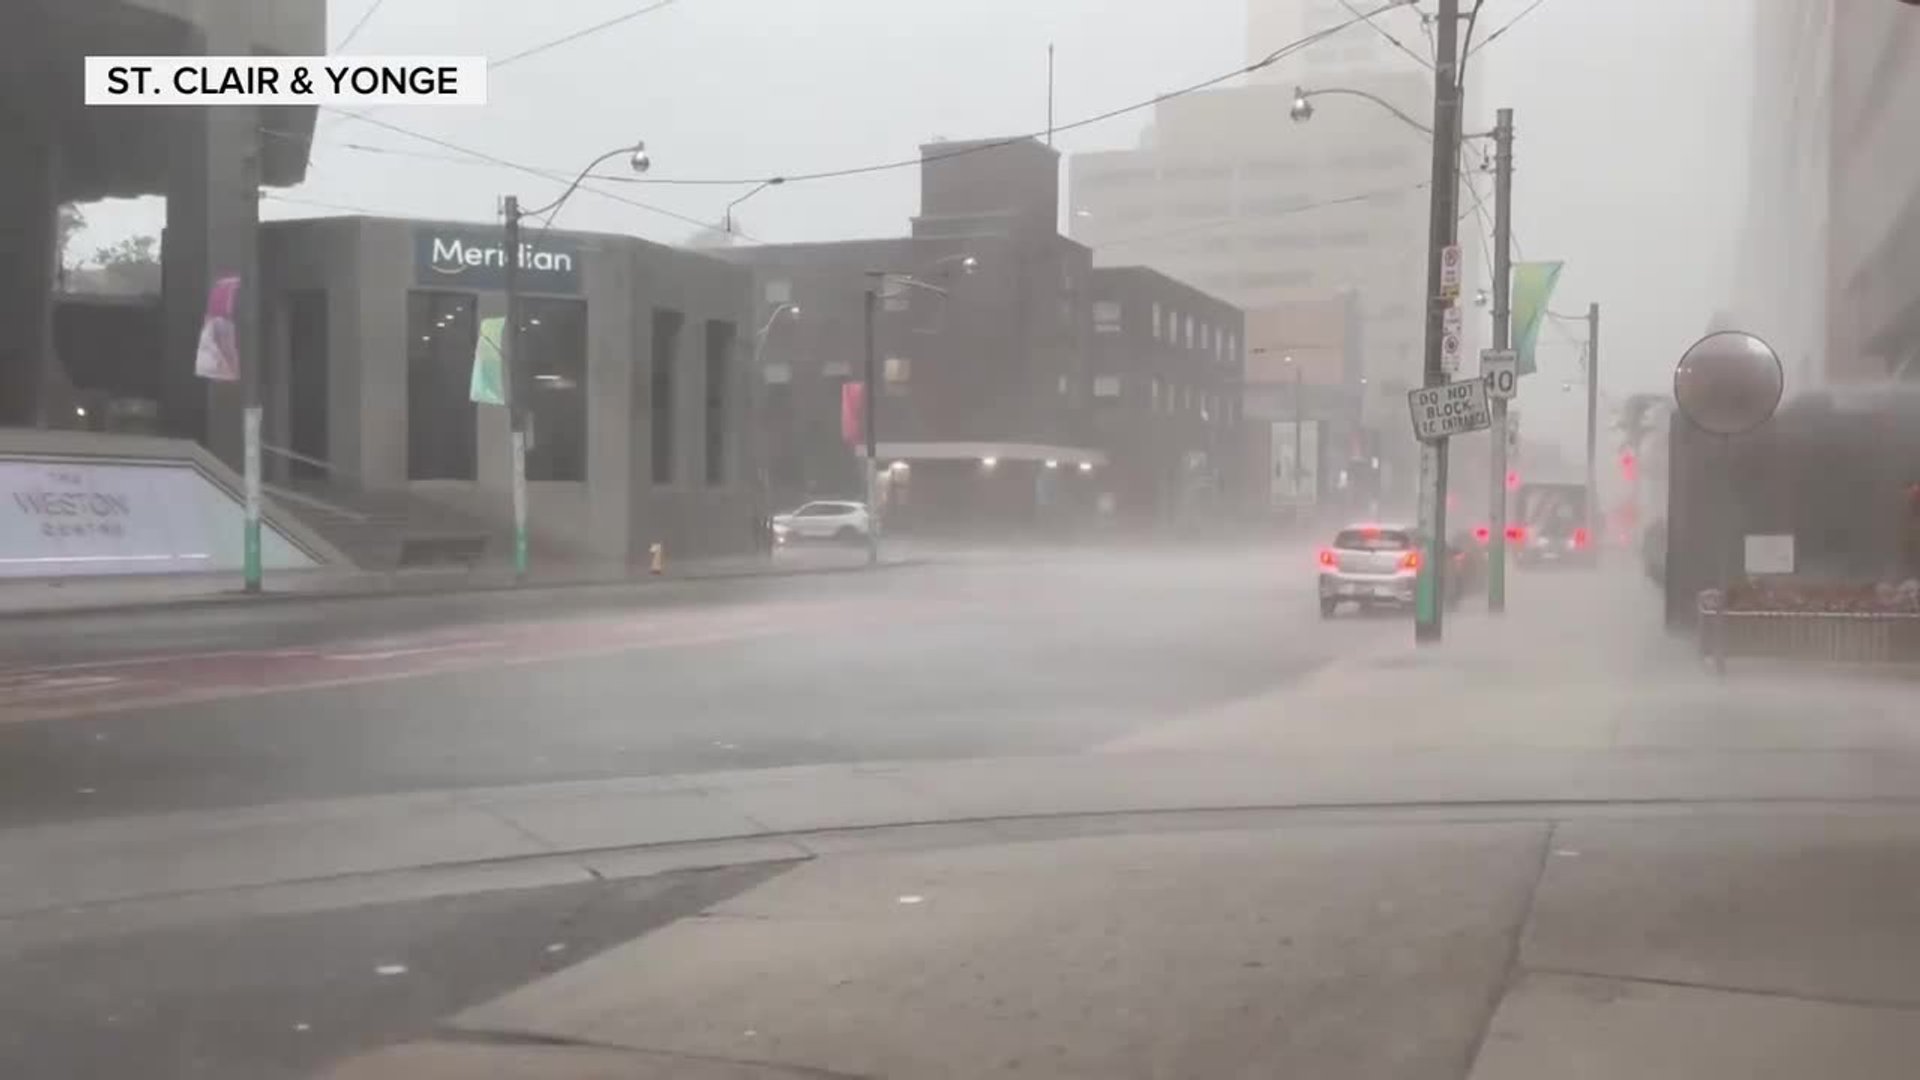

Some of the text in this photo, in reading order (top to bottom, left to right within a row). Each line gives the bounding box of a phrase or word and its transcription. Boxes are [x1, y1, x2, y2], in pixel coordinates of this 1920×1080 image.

[1484, 370, 1513, 392] 40
[1419, 384, 1473, 405] DO NOT
[1426, 399, 1471, 418] BLOCK
[12, 491, 130, 517] WESTON
